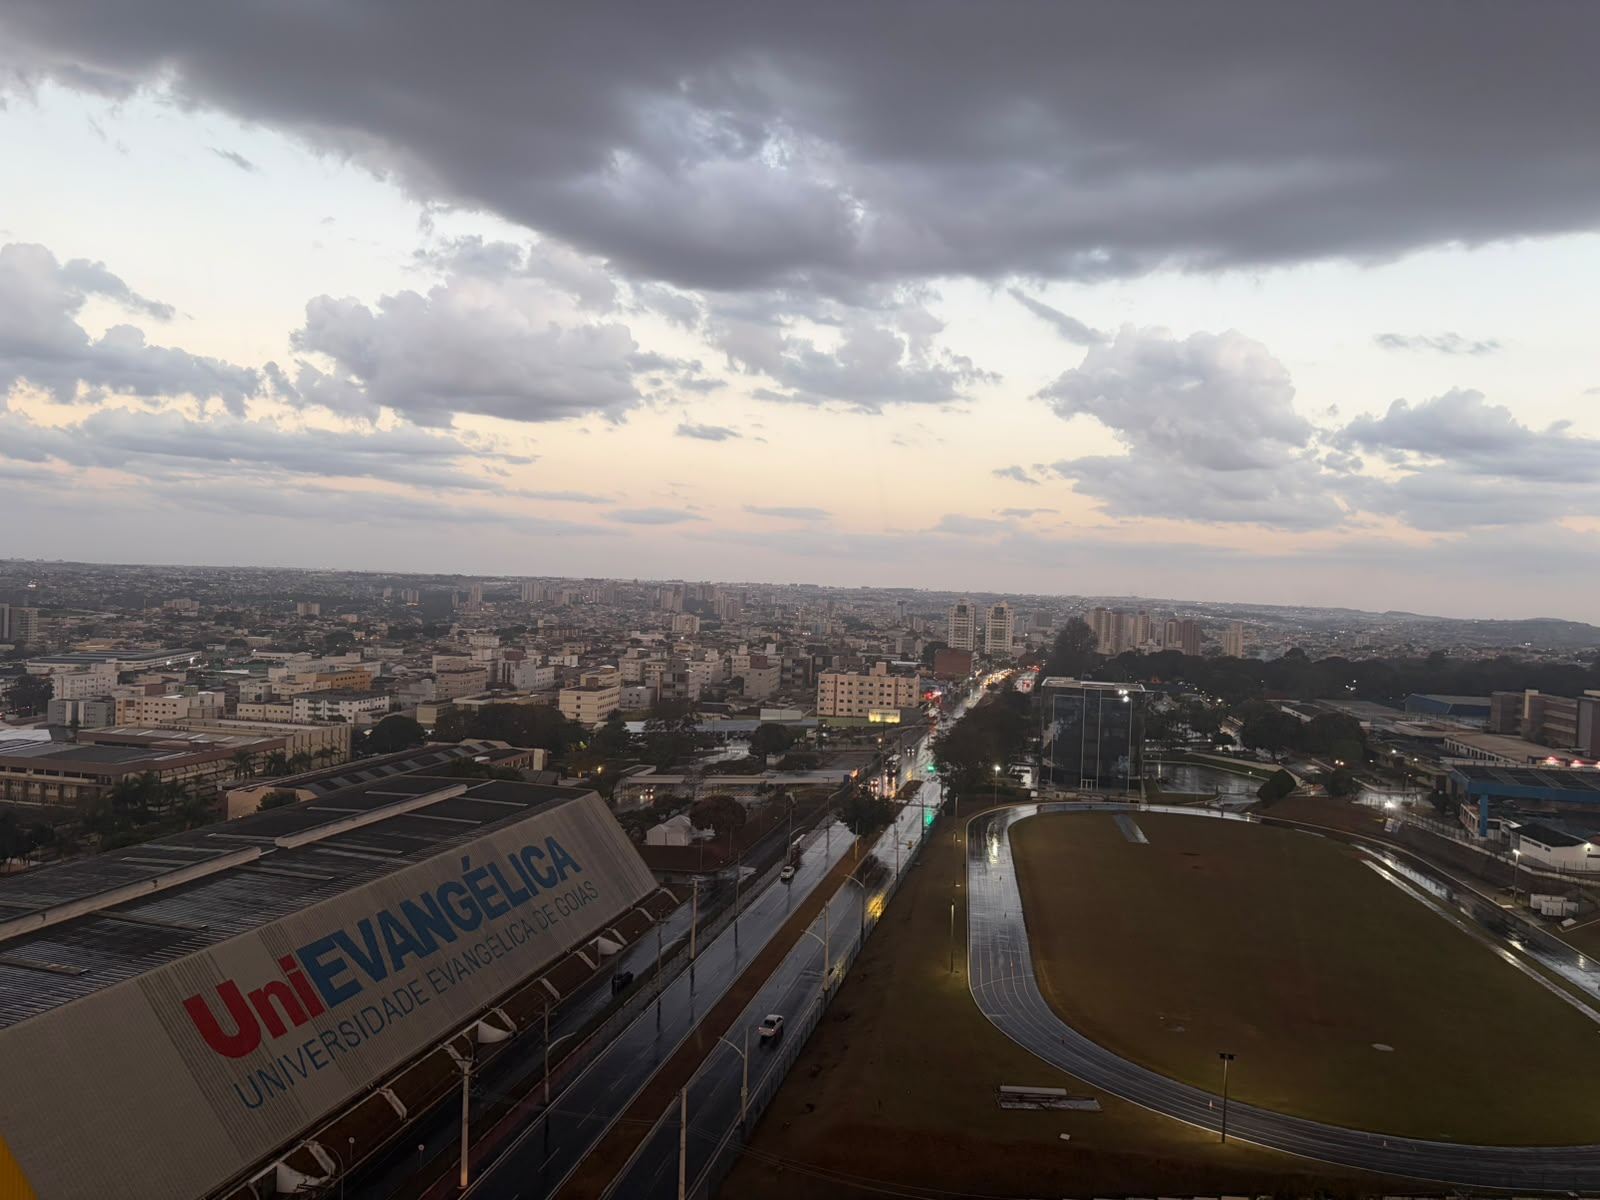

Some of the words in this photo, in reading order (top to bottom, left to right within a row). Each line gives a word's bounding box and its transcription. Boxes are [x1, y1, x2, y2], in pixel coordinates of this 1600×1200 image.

[183, 836, 582, 1058] UniEVANGÉLICA
[234, 979, 430, 1109] UNIVERSIDADE
[426, 919, 537, 994] EVANGÉLICA
[532, 903, 559, 930] DE
